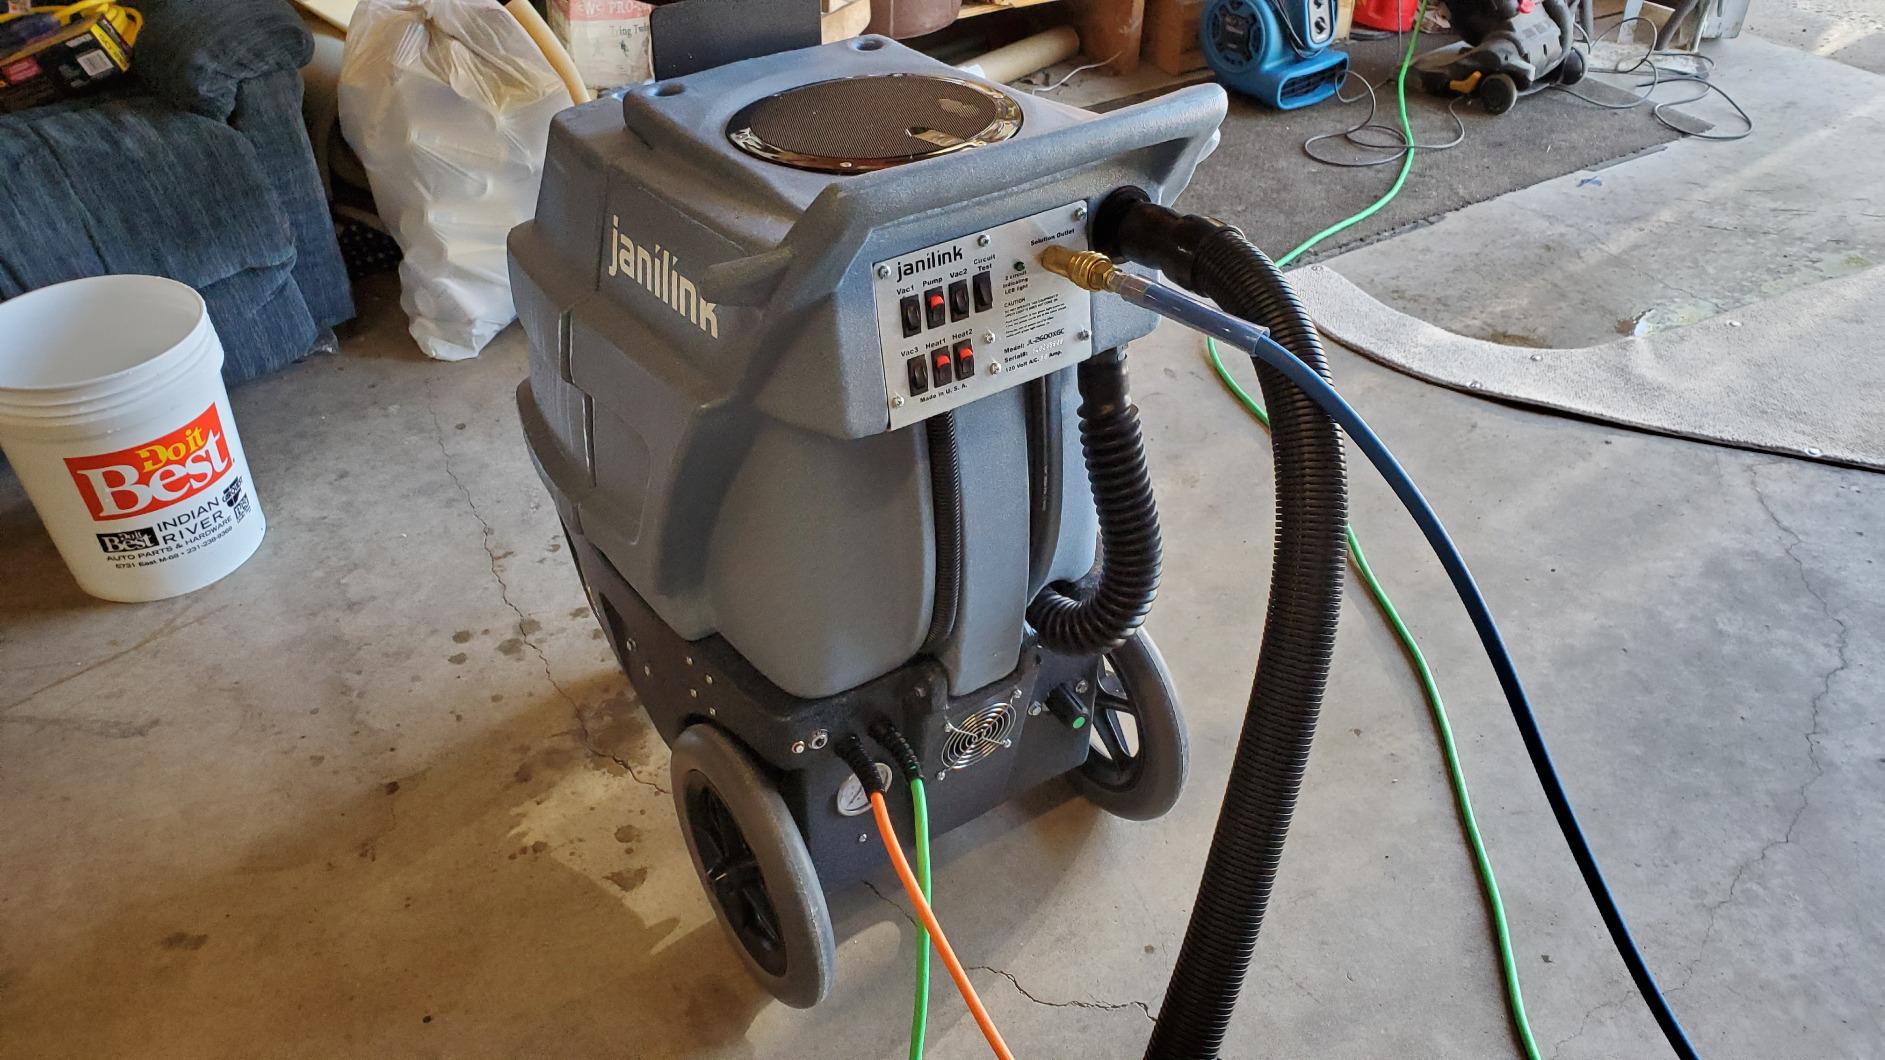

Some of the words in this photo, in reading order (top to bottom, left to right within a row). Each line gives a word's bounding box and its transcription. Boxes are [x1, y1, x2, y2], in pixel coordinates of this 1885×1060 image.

[1030, 234, 1055, 246] Solution
[1056, 228, 1075, 238] Outlet
[897, 245, 963, 283] janilink
[973, 253, 996, 265] Circuit
[949, 268, 968, 278] Vac2
[977, 263, 992, 271] Test
[608, 214, 718, 339] janilink
[922, 277, 943, 287] Pump
[896, 284, 914, 295] Vac1
[1004, 297, 1026, 308] CAUTION
[952, 328, 973, 340] Heat2
[925, 338, 946, 349] Heat1
[900, 346, 919, 357] Vac3
[920, 394, 937, 402] Made
[136, 444, 186, 473] Do
[185, 426, 206, 450] it
[77, 428, 229, 517] Best
[157, 496, 220, 532] INDIAN
[101, 533, 155, 552] Best
[162, 510, 224, 545] RIVER
[107, 554, 135, 562] AUTO
[138, 546, 173, 559] PARTS
[185, 515, 232, 545] HARDWARE
[138, 559, 157, 567] East
